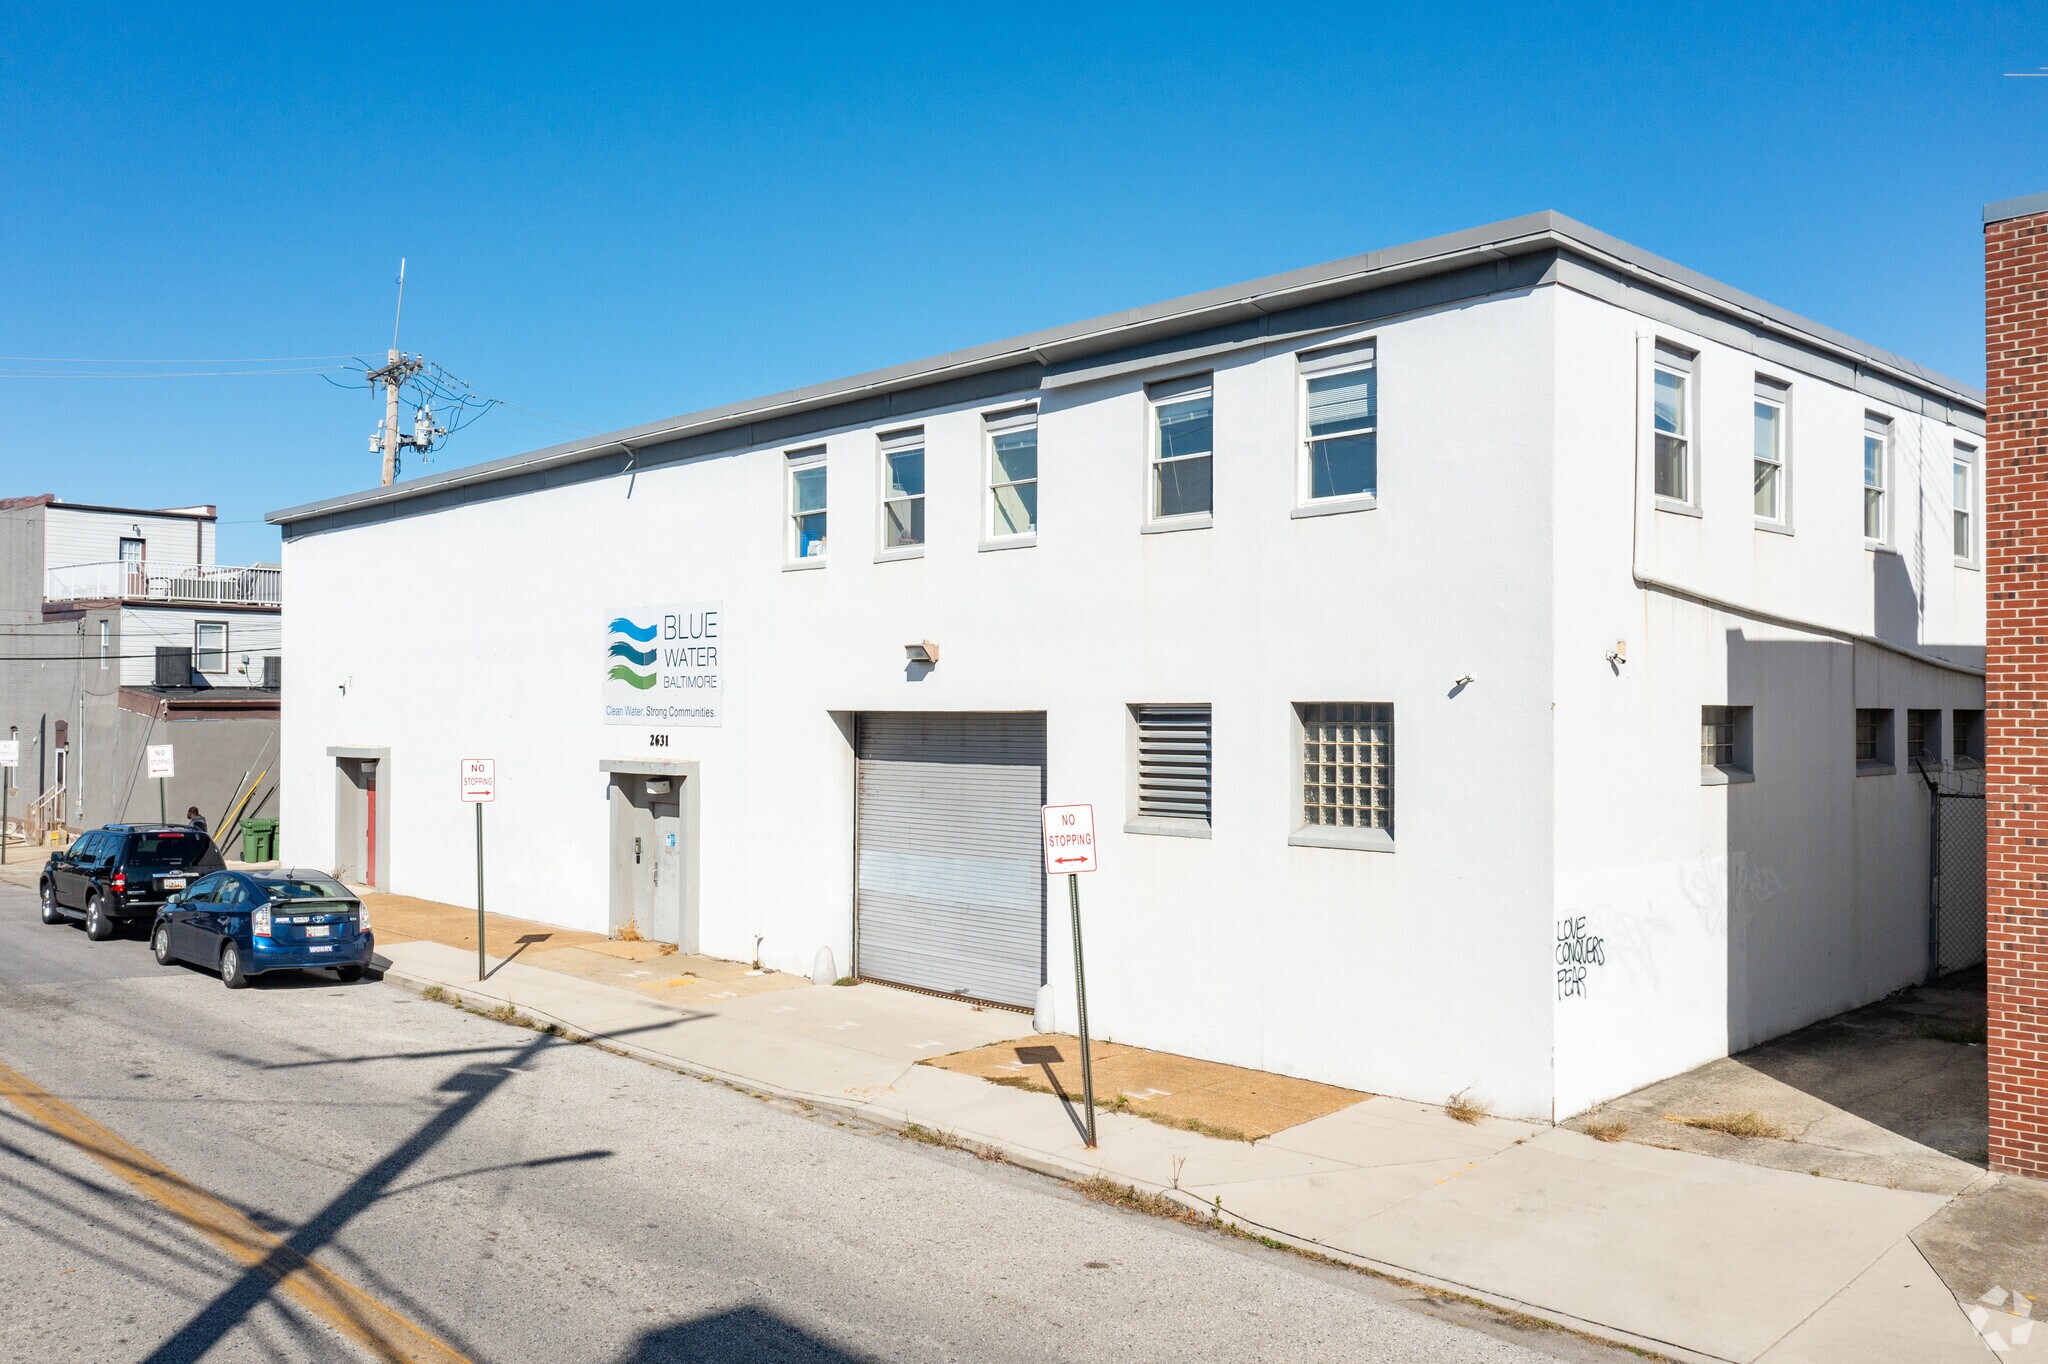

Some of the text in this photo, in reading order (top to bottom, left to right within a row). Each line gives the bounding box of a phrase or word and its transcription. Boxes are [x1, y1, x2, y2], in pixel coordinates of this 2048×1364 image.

[664, 612, 717, 640] BLUE
[664, 647, 718, 667] WATER
[664, 675, 717, 689] BALTIMORE
[606, 705, 623, 716] Clean
[646, 706, 668, 719] Strong
[668, 706, 717, 718] Communities.
[650, 734, 669, 747] 2631
[471, 764, 485, 772] NO
[464, 777, 493, 786] STOPPING
[1061, 813, 1076, 826] NO
[1049, 833, 1092, 847] STOPPING
[1557, 916, 1586, 941] LOVE
[1555, 936, 1605, 966] CONQUERS
[1557, 966, 1587, 1001] FEAR
